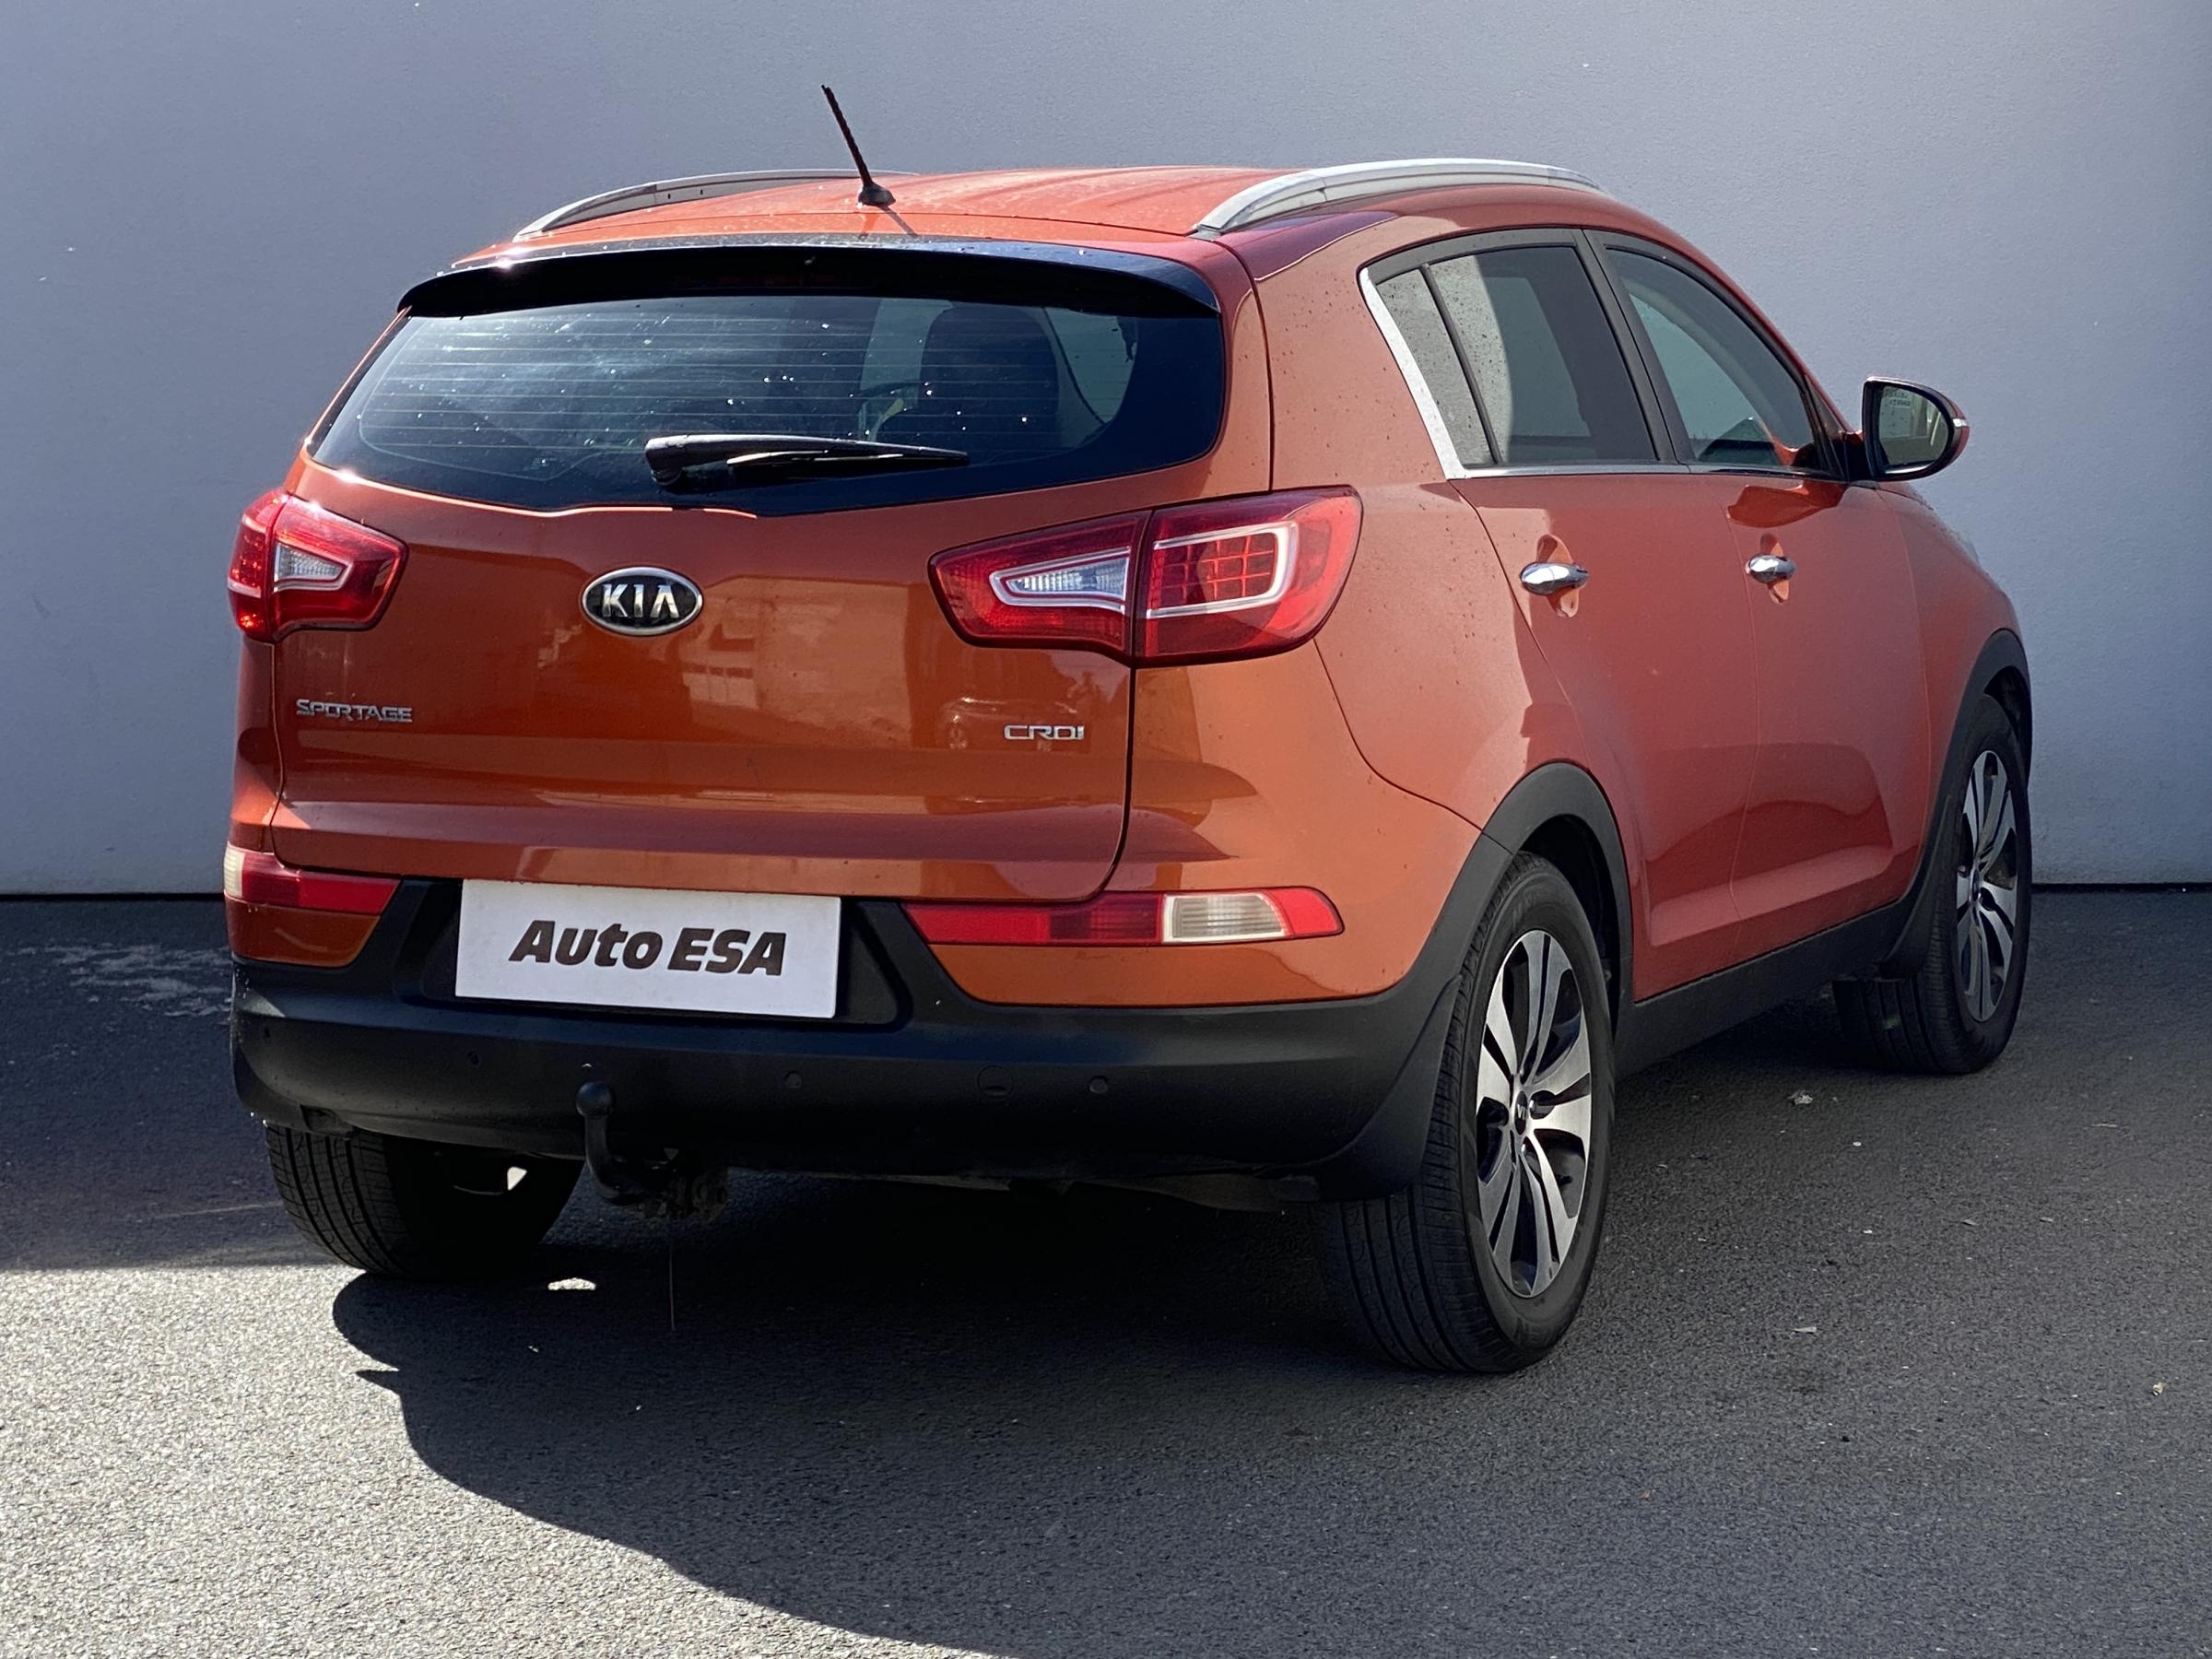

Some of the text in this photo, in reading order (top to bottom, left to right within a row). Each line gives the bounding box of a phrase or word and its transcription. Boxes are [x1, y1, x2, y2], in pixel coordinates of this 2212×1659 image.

[602, 583, 680, 618] KIA
[296, 699, 413, 724] SPORTAGE
[509, 920, 787, 976] Auto ESA
